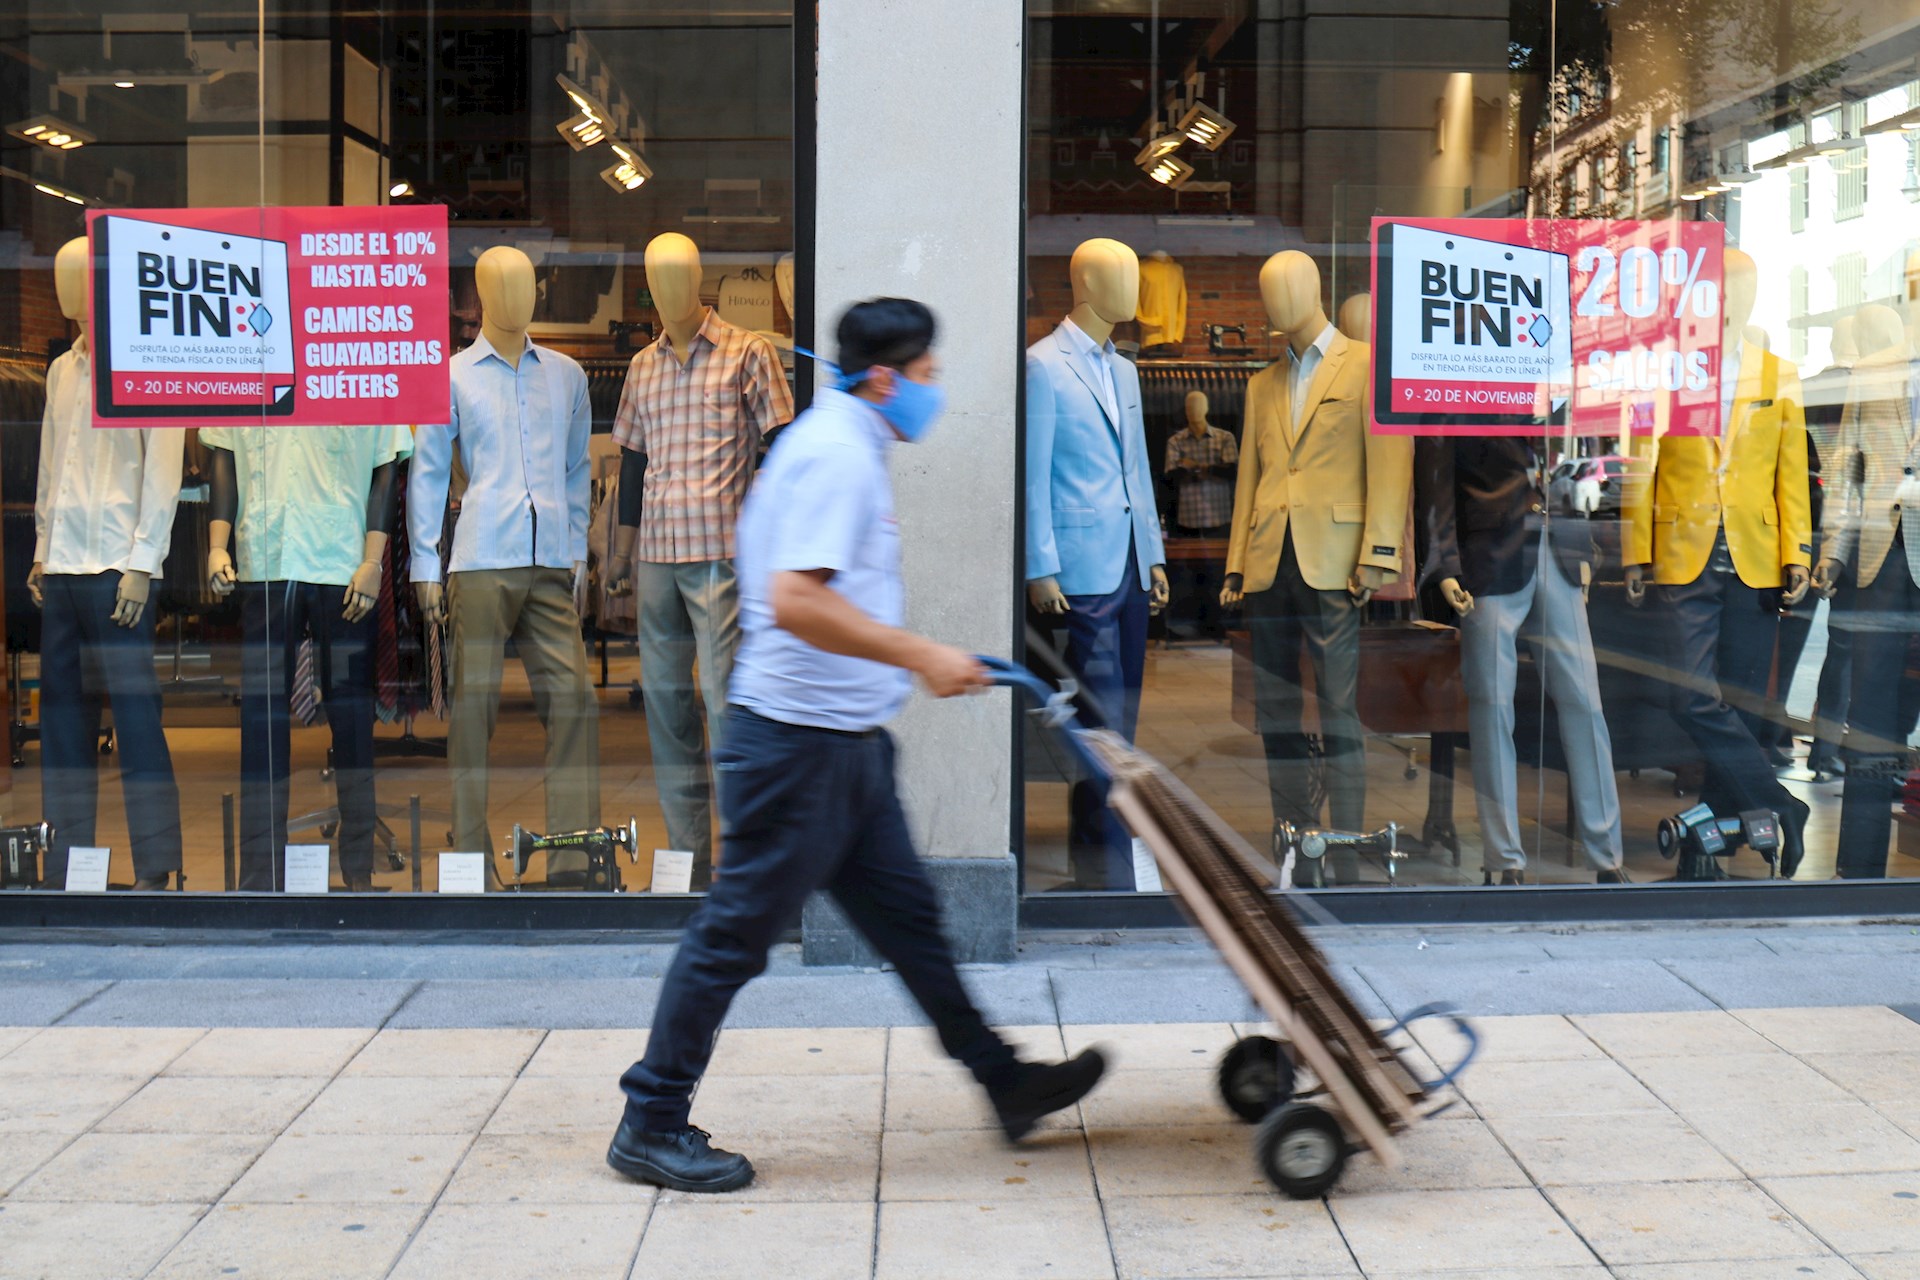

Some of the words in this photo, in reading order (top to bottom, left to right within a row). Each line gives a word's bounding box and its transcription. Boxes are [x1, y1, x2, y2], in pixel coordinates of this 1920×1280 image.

[301, 233, 364, 256] DESDE
[368, 233, 390, 255] EL
[393, 232, 436, 255] 10%
[137, 251, 261, 298] BUEN
[311, 264, 377, 288] HASTA
[380, 263, 427, 287] 50%
[1421, 259, 1543, 309] BUEN
[1577, 246, 1718, 318] 20%
[304, 305, 414, 334] CAMISAS
[130, 345, 168, 353] DISFRUTA
[170, 345, 180, 354] LO
[184, 344, 201, 354] MÁS
[204, 346, 237, 355] BARATO
[239, 346, 253, 354] DEL
[156, 356, 185, 364] TIENDA
[188, 354, 213, 364] FÍSICA
[216, 356, 224, 364] O
[226, 357, 237, 365] EN
[240, 355, 263, 365] LÍNEA
[305, 340, 443, 368] GUAYABERAS
[1411, 352, 1448, 361] DISFRUTA
[1451, 354, 1461, 362] LO
[1464, 353, 1482, 363] MÁS
[1484, 355, 1517, 364] BARATO
[1518, 356, 1532, 364] DEL
[1535, 355, 1554, 365] AÑO
[1423, 363, 1434, 371] EN
[1437, 364, 1466, 373] TIENDA
[1468, 363, 1493, 373] FÍSICA
[1495, 366, 1503, 374] O
[1505, 366, 1517, 374] EN
[1519, 365, 1542, 375] LÍNEA
[1588, 350, 1709, 392] SACOS
[124, 380, 134, 393] 9
[144, 380, 162, 394] 20
[165, 381, 183, 394] DE
[186, 381, 264, 396] NOVIEMBRE
[305, 370, 399, 399] SUÉTERS
[1404, 388, 1414, 401] 9
[1424, 388, 1442, 402] 20
[1445, 389, 1461, 403] DE
[1465, 390, 1541, 405] NOVIEMBRE
[553, 837, 584, 846] SINGER
